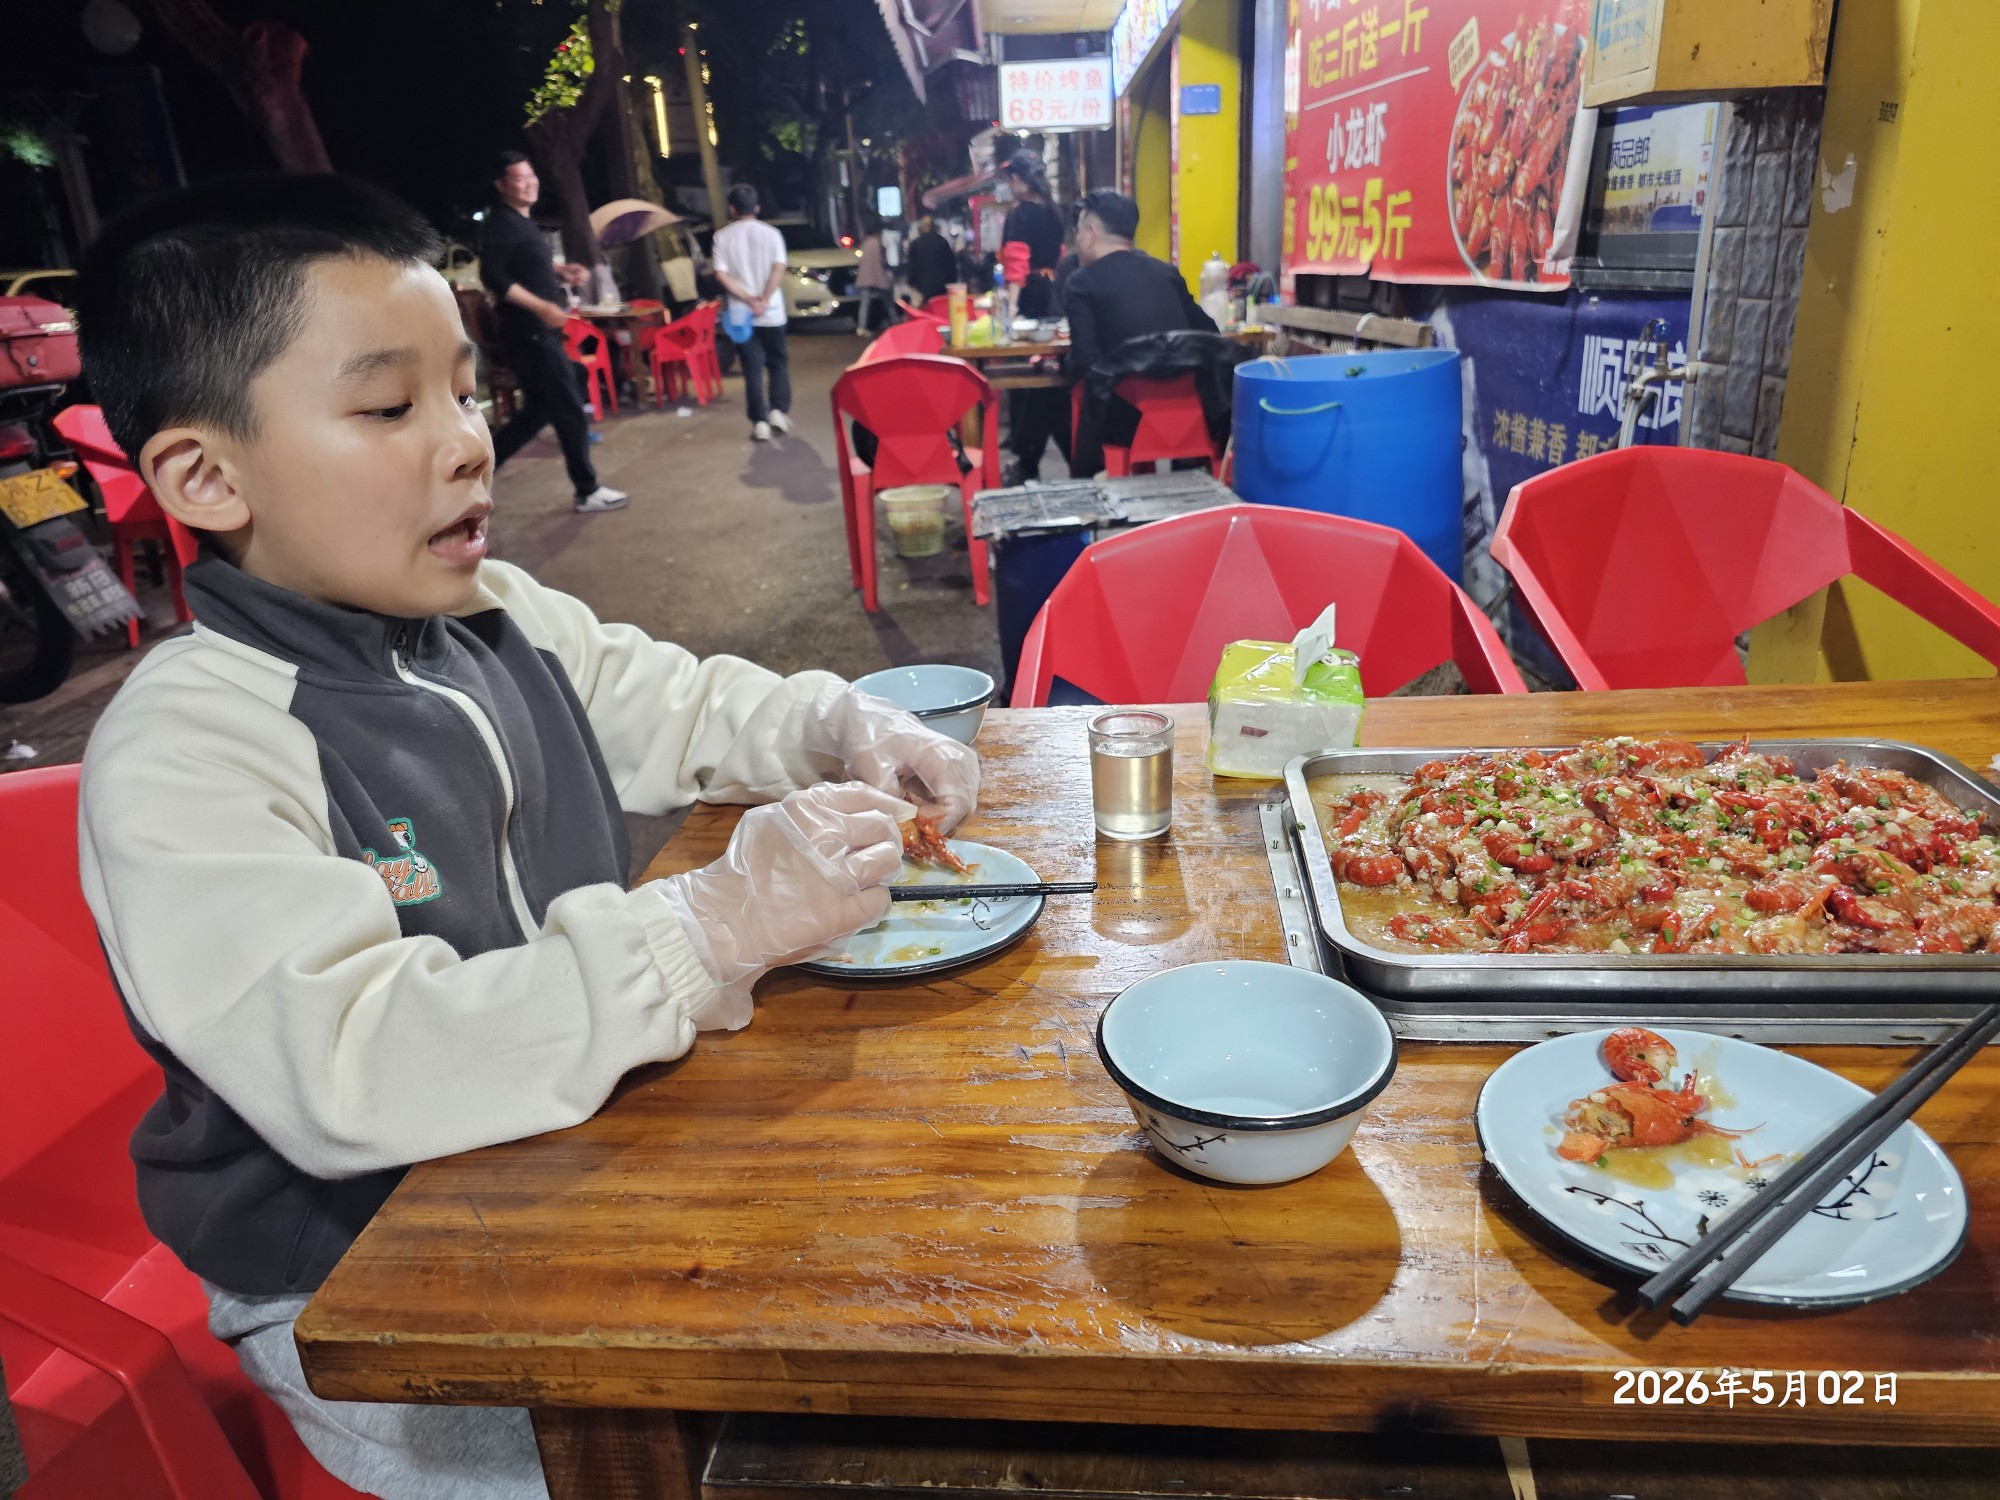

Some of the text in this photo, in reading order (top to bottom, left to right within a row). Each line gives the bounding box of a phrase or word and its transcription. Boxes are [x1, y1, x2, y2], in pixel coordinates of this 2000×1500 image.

[1308, 0, 1429, 88] 吃三斤送一斤
[1009, 68, 1104, 93] 特价烤鱼
[1009, 97, 1101, 122] 68元/份
[1327, 102, 1388, 174] 小龙虾
[1306, 177, 1413, 264] 99元5斤
[1493, 409, 1567, 465] 浓酱兼香
